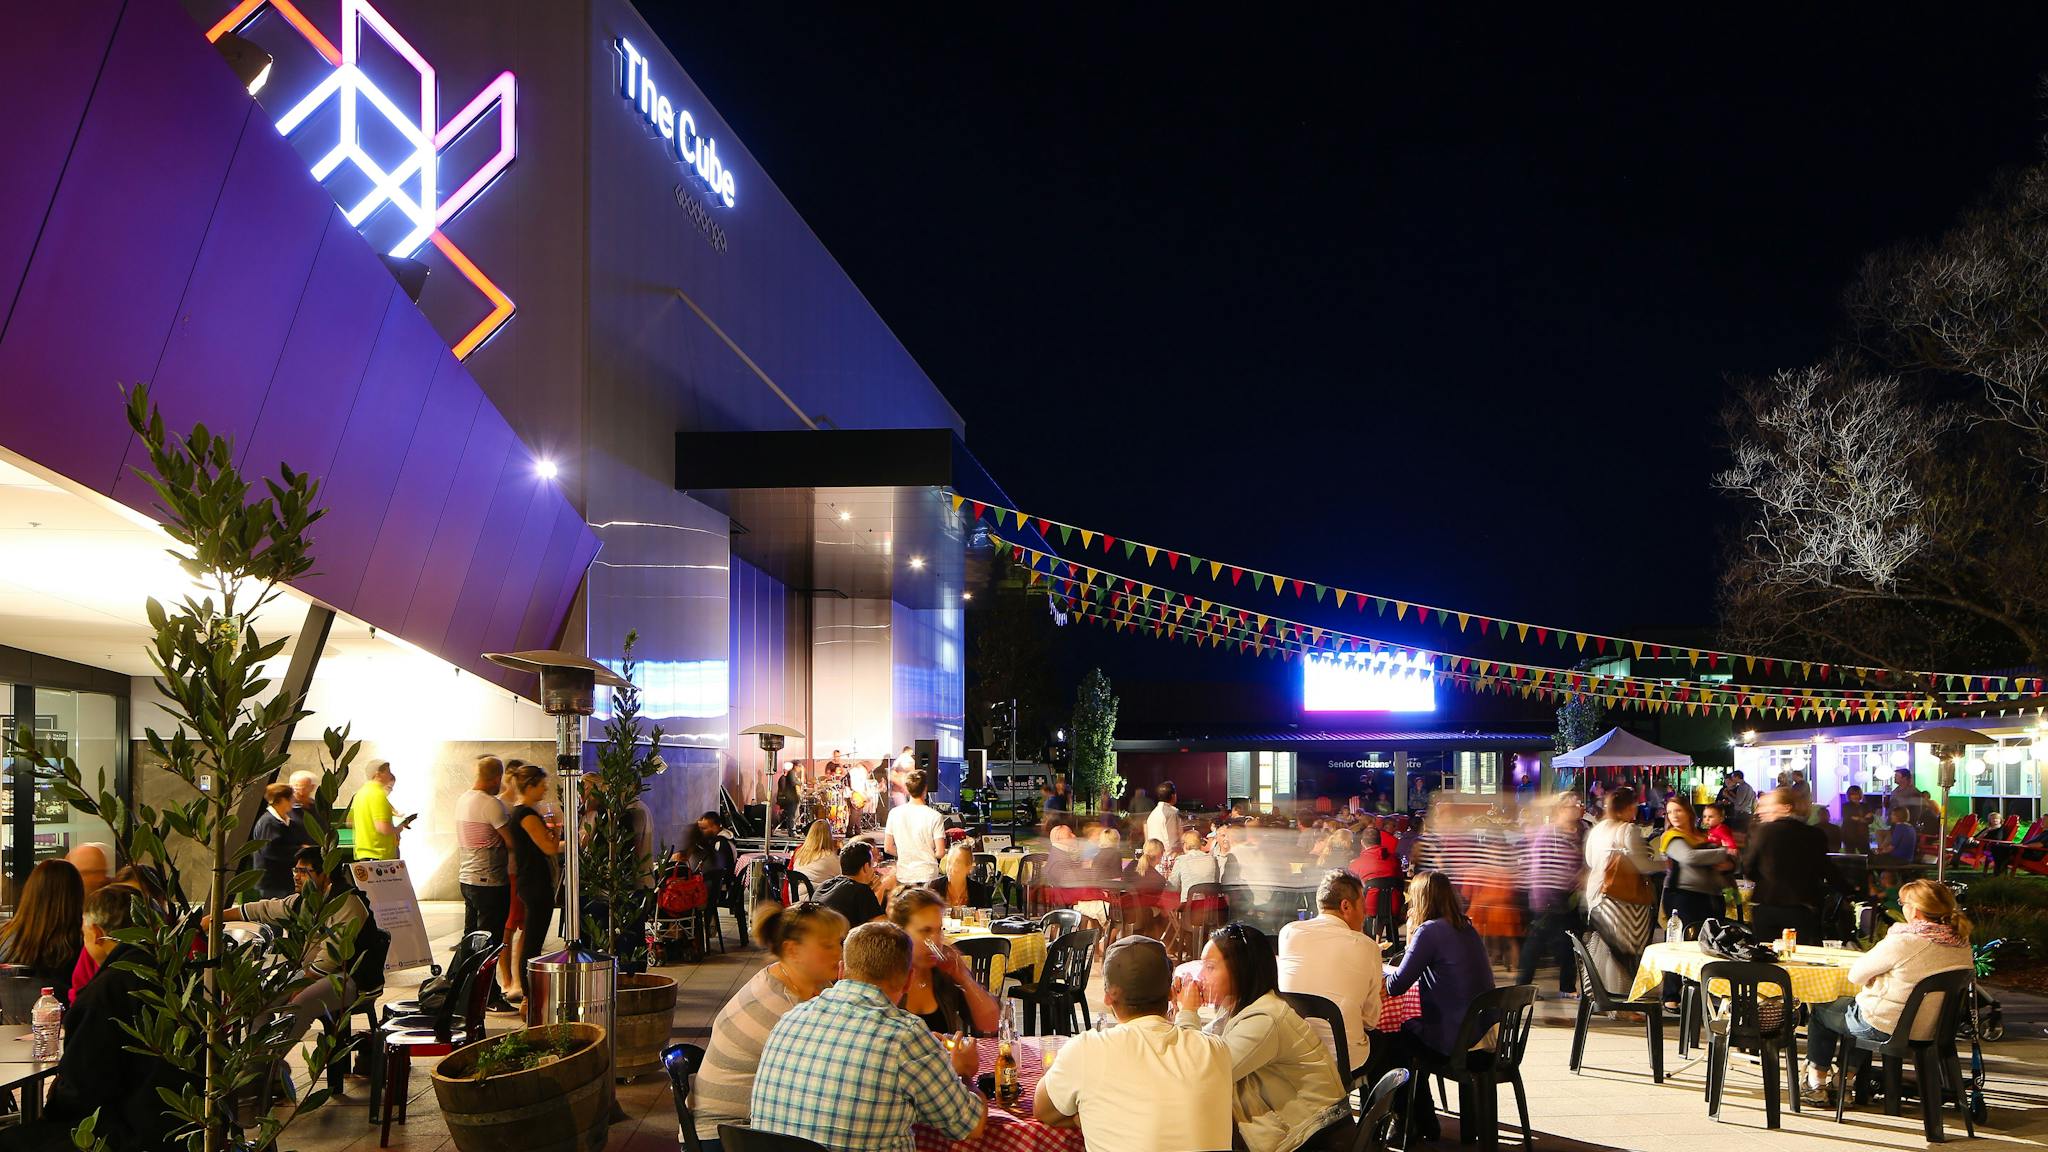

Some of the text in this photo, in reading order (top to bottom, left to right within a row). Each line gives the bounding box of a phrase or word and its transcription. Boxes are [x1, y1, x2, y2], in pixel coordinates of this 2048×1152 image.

[622, 37, 735, 208] The Cube
[1328, 760, 1354, 768] Senior
[1356, 760, 1392, 768] Citizens'
